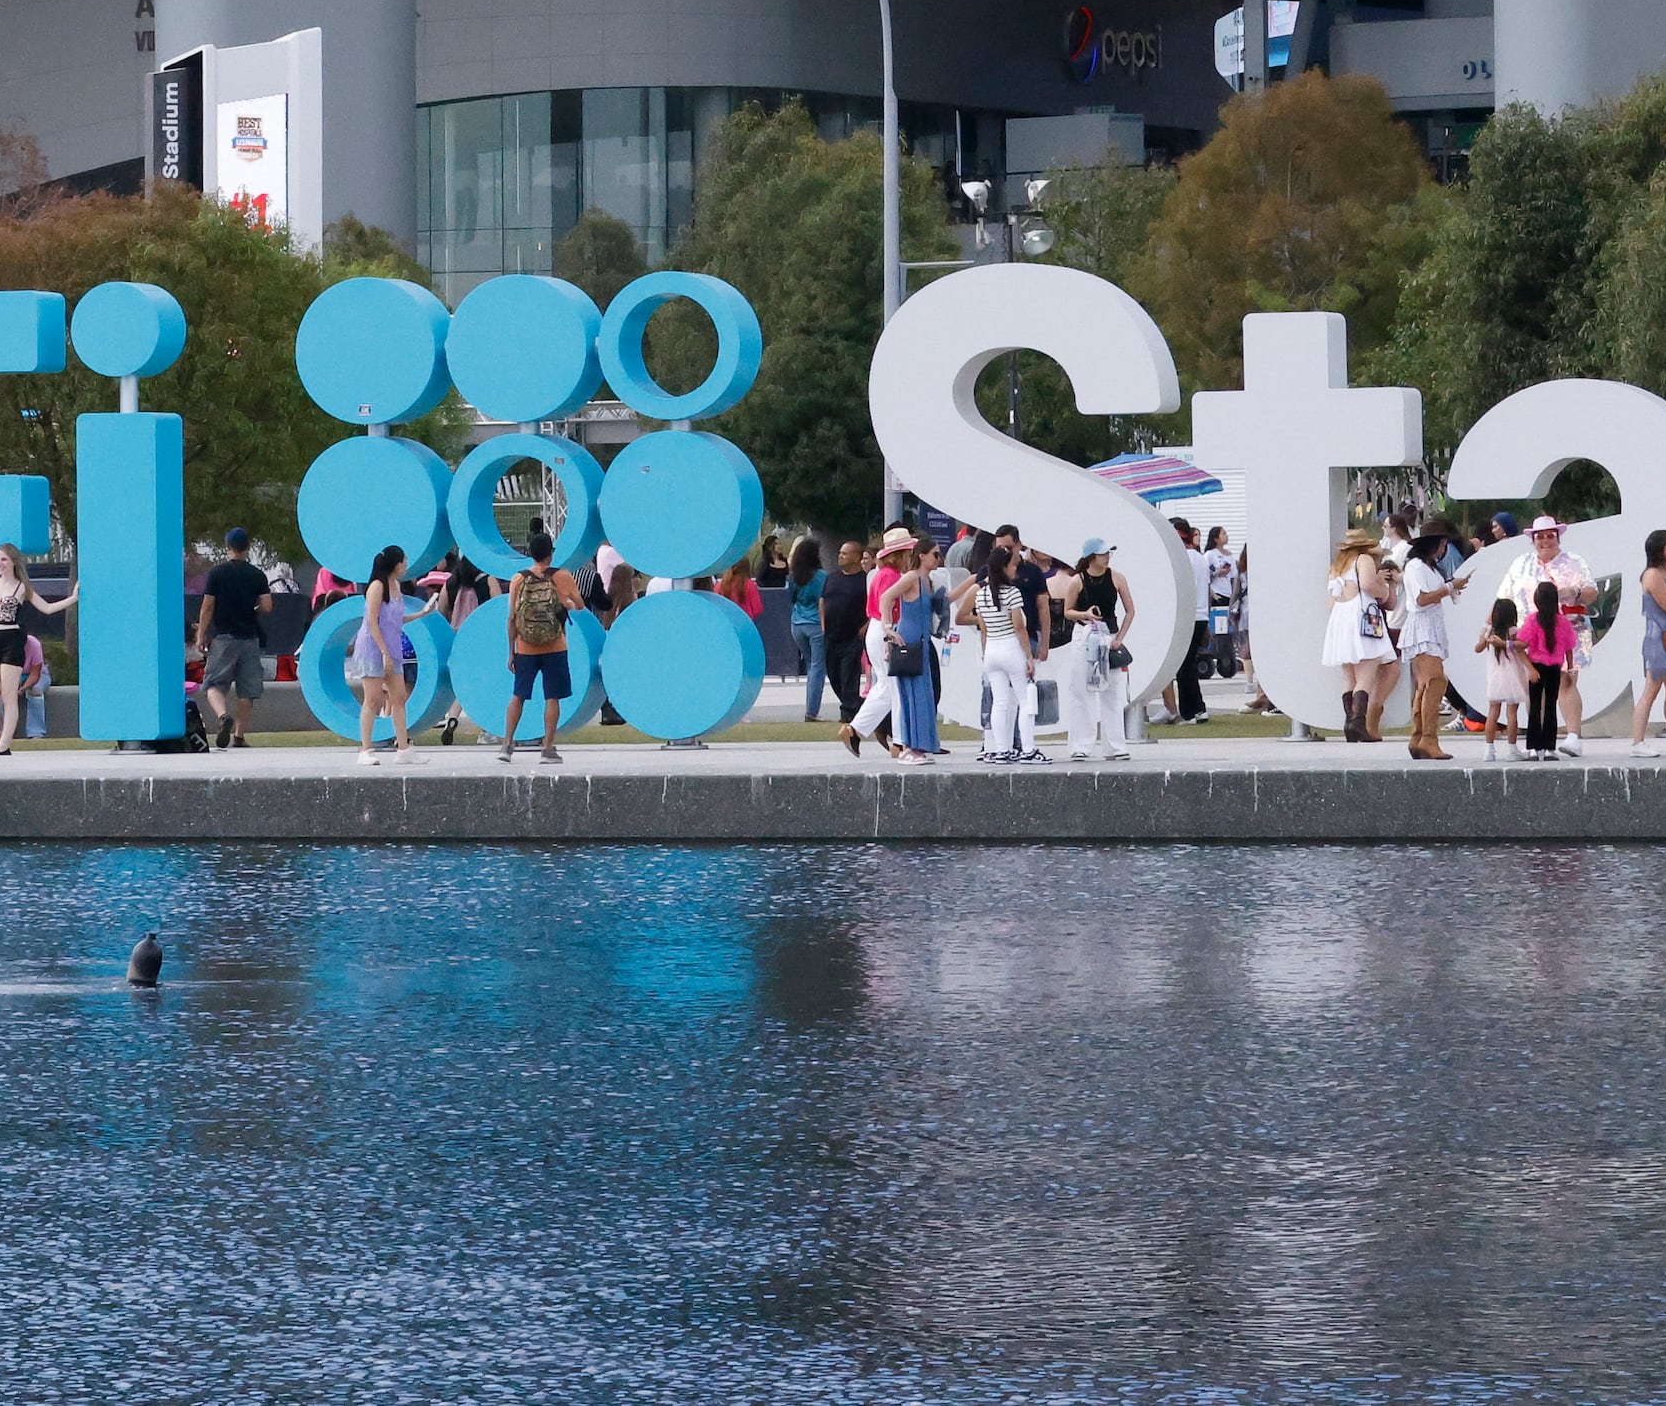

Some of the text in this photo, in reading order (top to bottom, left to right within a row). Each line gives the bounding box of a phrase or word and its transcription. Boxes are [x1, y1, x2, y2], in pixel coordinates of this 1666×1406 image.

[1102, 24, 1162, 75] pepsi
[162, 82, 179, 180] Stadium
[237, 116, 263, 129] BEST
